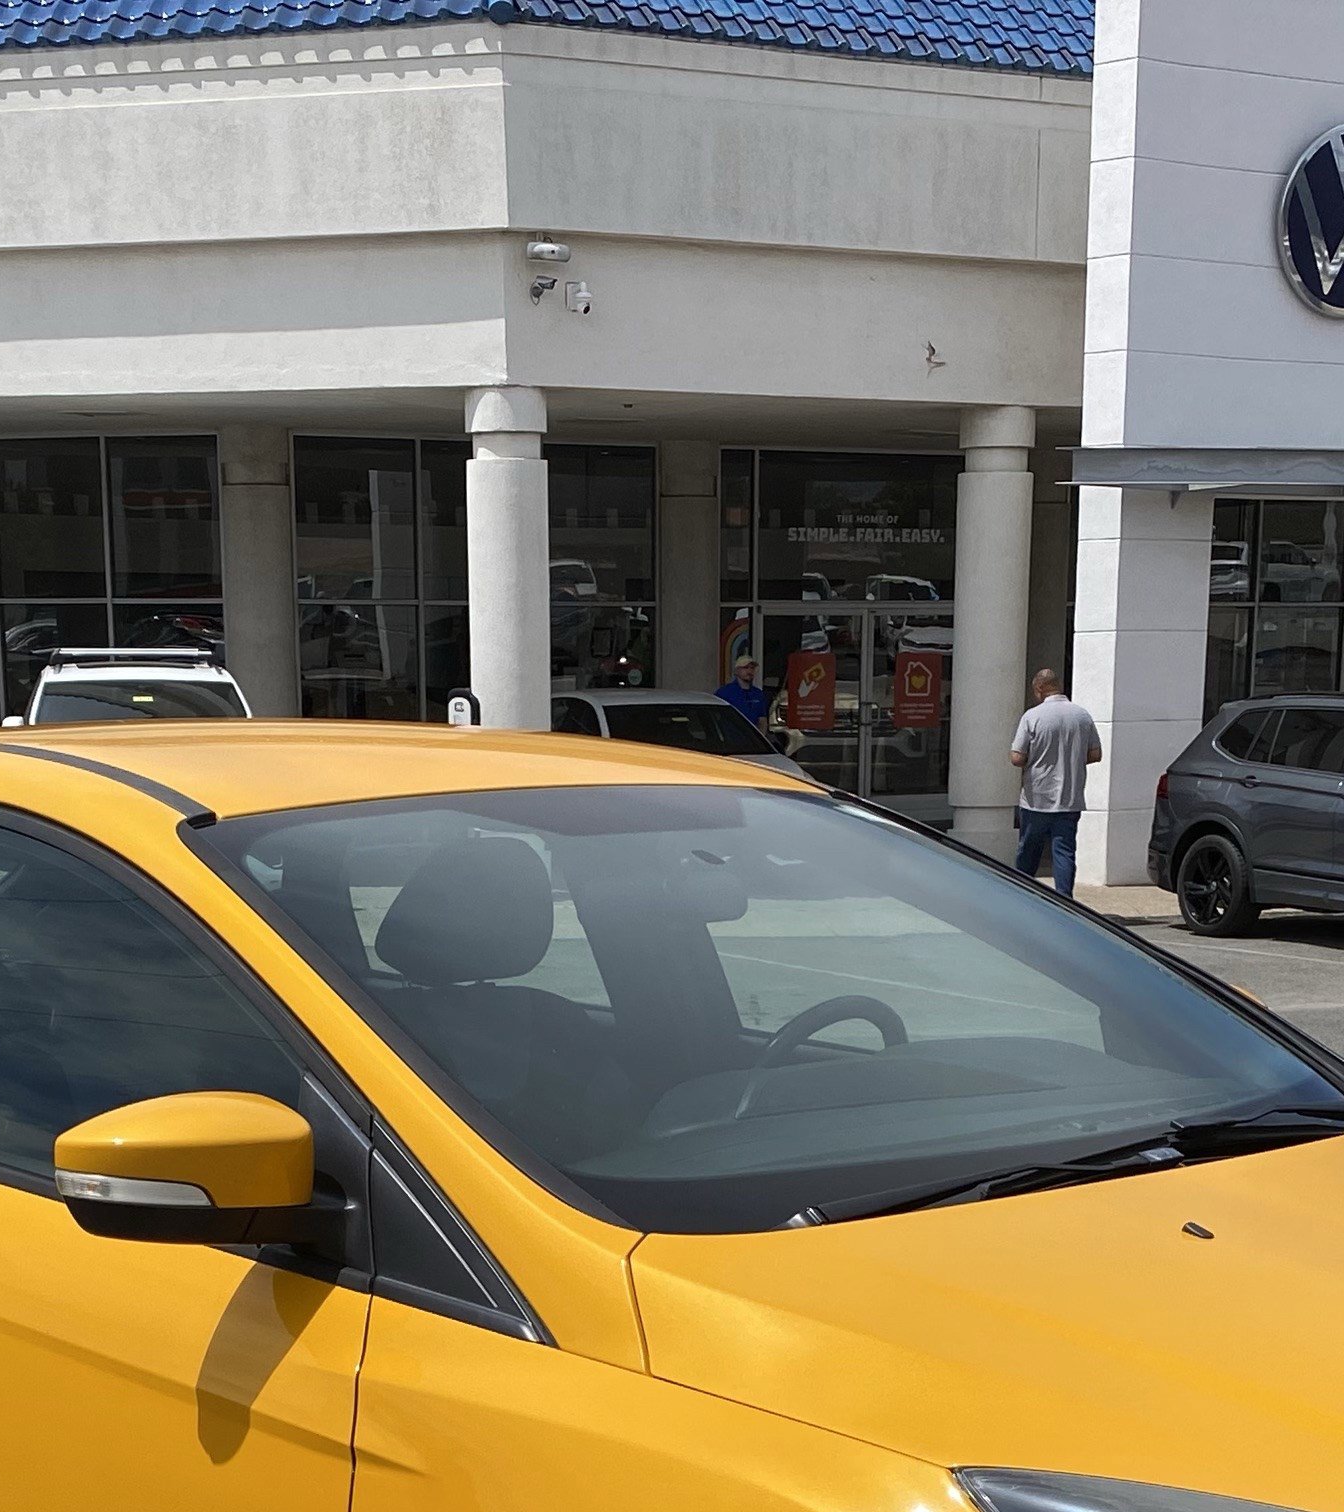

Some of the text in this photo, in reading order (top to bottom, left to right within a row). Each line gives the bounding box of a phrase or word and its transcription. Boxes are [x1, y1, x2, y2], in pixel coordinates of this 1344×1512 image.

[836, 514, 899, 525] THE HOME OF
